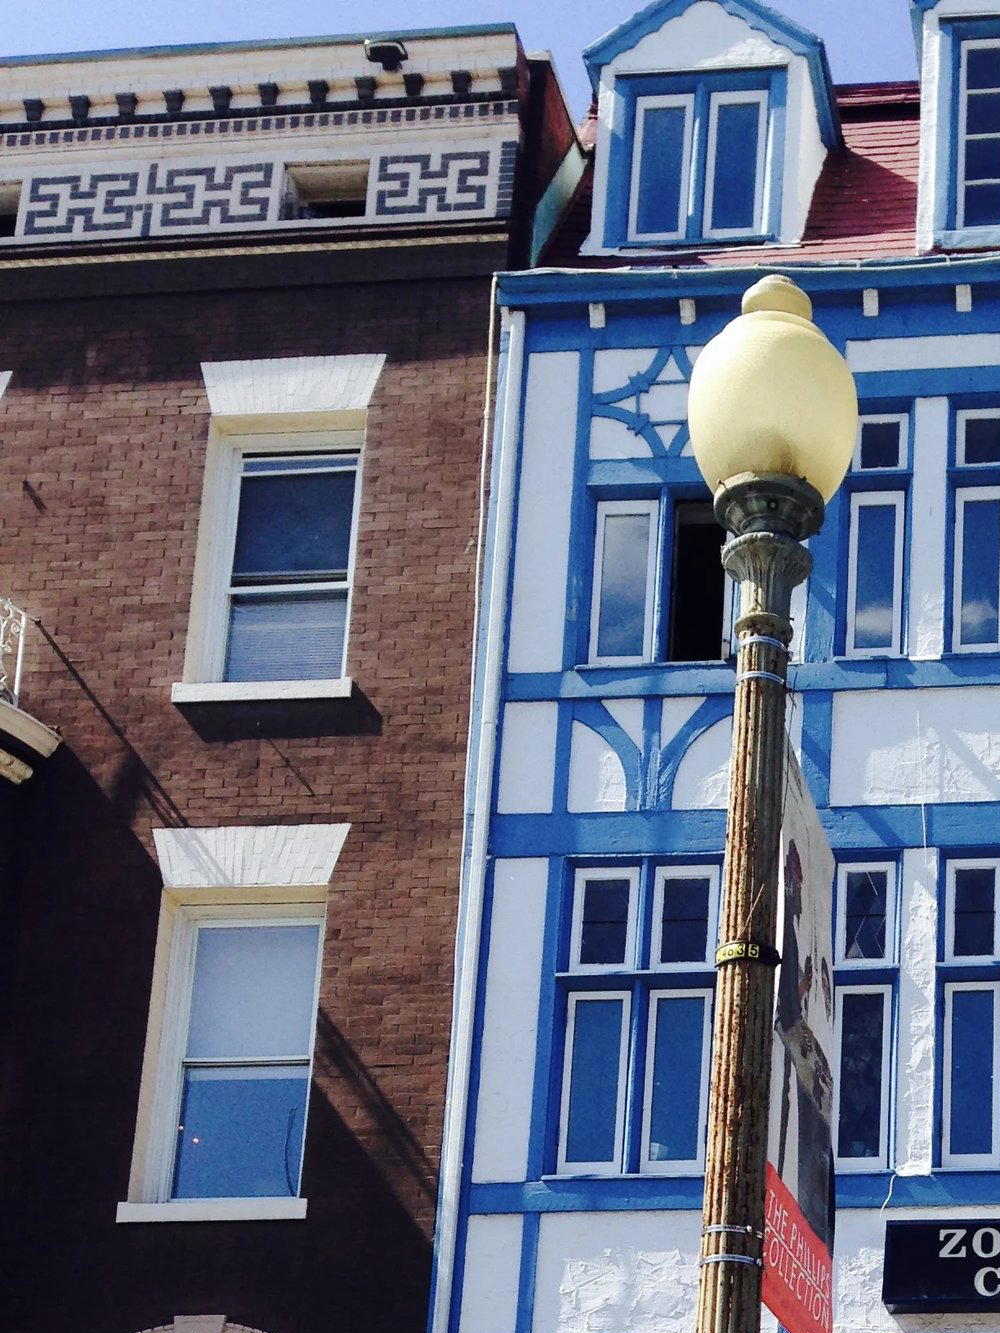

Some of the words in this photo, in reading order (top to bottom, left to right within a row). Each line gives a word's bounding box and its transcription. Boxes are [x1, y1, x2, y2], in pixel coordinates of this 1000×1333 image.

[764, 1226, 829, 1331] COLLECTION
[767, 1190, 788, 1239] THE
[790, 1222, 830, 1298] PHILLIPS
